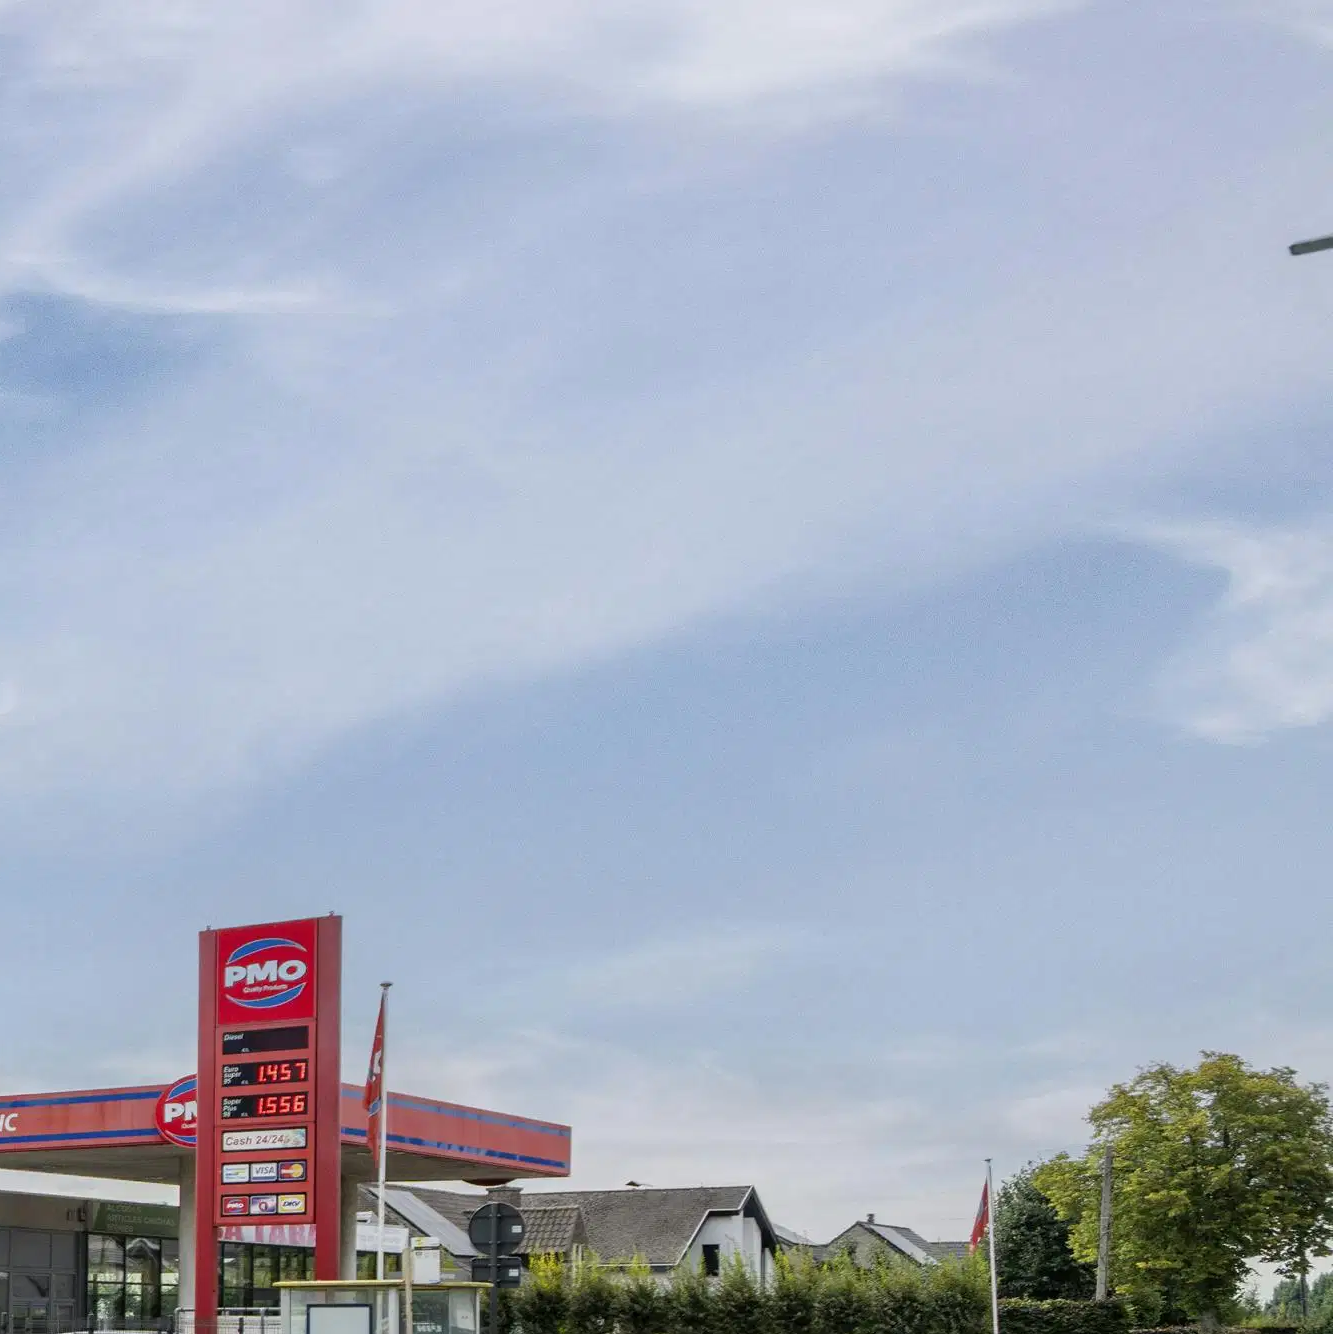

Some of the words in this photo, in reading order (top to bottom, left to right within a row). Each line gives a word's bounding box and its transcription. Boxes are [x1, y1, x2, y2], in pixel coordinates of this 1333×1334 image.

[224, 959, 307, 988] PMO
[224, 1066, 239, 1074] Euro
[225, 1136, 253, 1146] Cash
[255, 1166, 274, 1175] VISA
